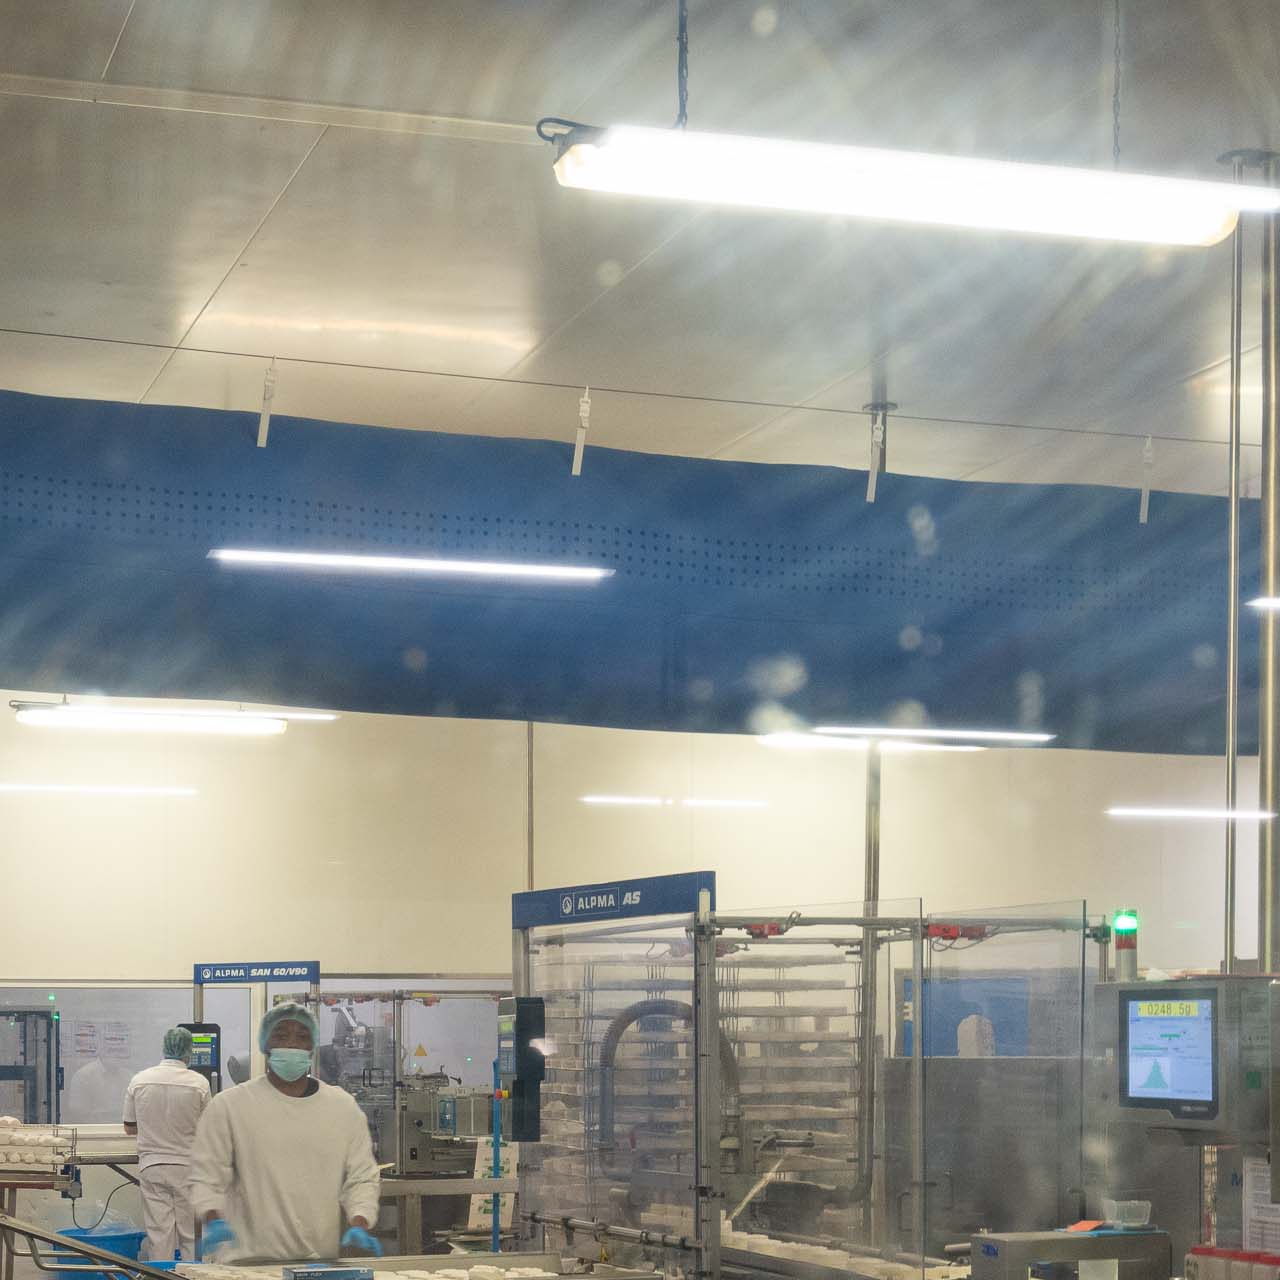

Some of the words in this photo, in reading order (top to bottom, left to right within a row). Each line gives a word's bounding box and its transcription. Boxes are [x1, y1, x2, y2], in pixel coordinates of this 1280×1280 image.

[578, 894, 615, 910] ALPMA
[623, 891, 641, 905] AS
[215, 968, 245, 977] ALPMA
[250, 968, 271, 977] SAN
